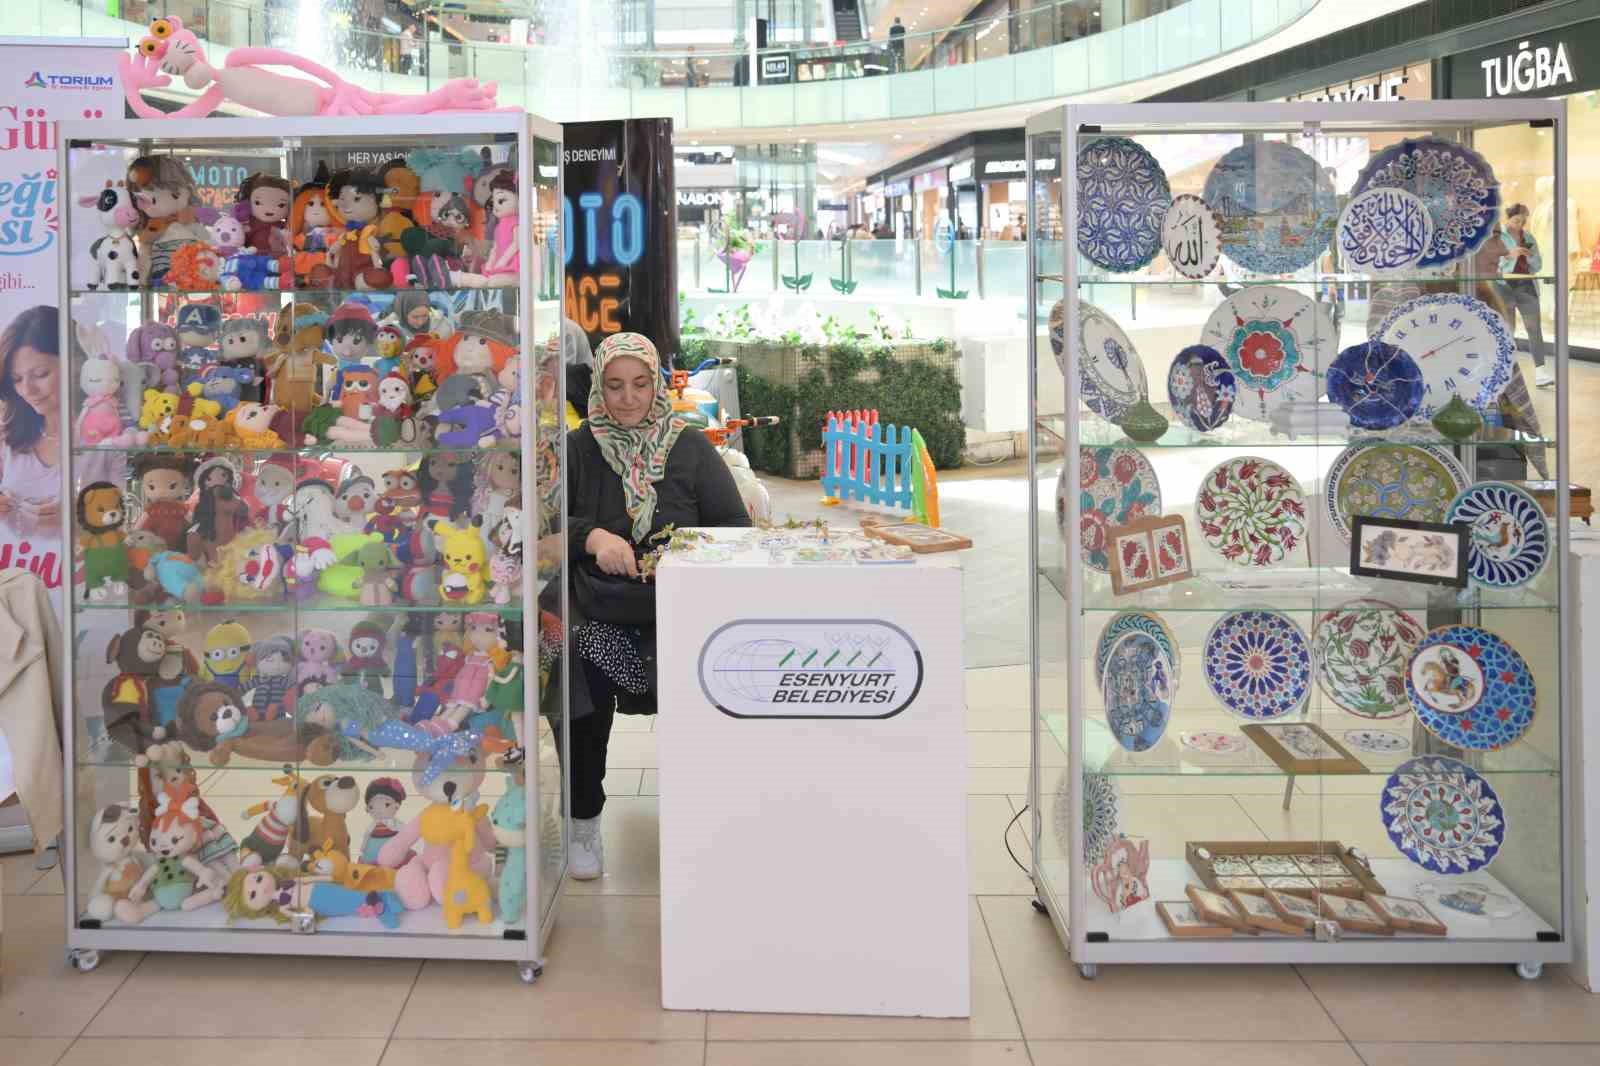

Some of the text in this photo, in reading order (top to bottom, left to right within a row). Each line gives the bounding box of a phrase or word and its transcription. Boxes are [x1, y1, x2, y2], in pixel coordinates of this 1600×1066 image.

[1481, 41, 1573, 97] TUĞBA
[347, 151, 370, 165] HER
[779, 673, 895, 686] ESENYURT
[772, 687, 897, 703] BELEDİYESİ
